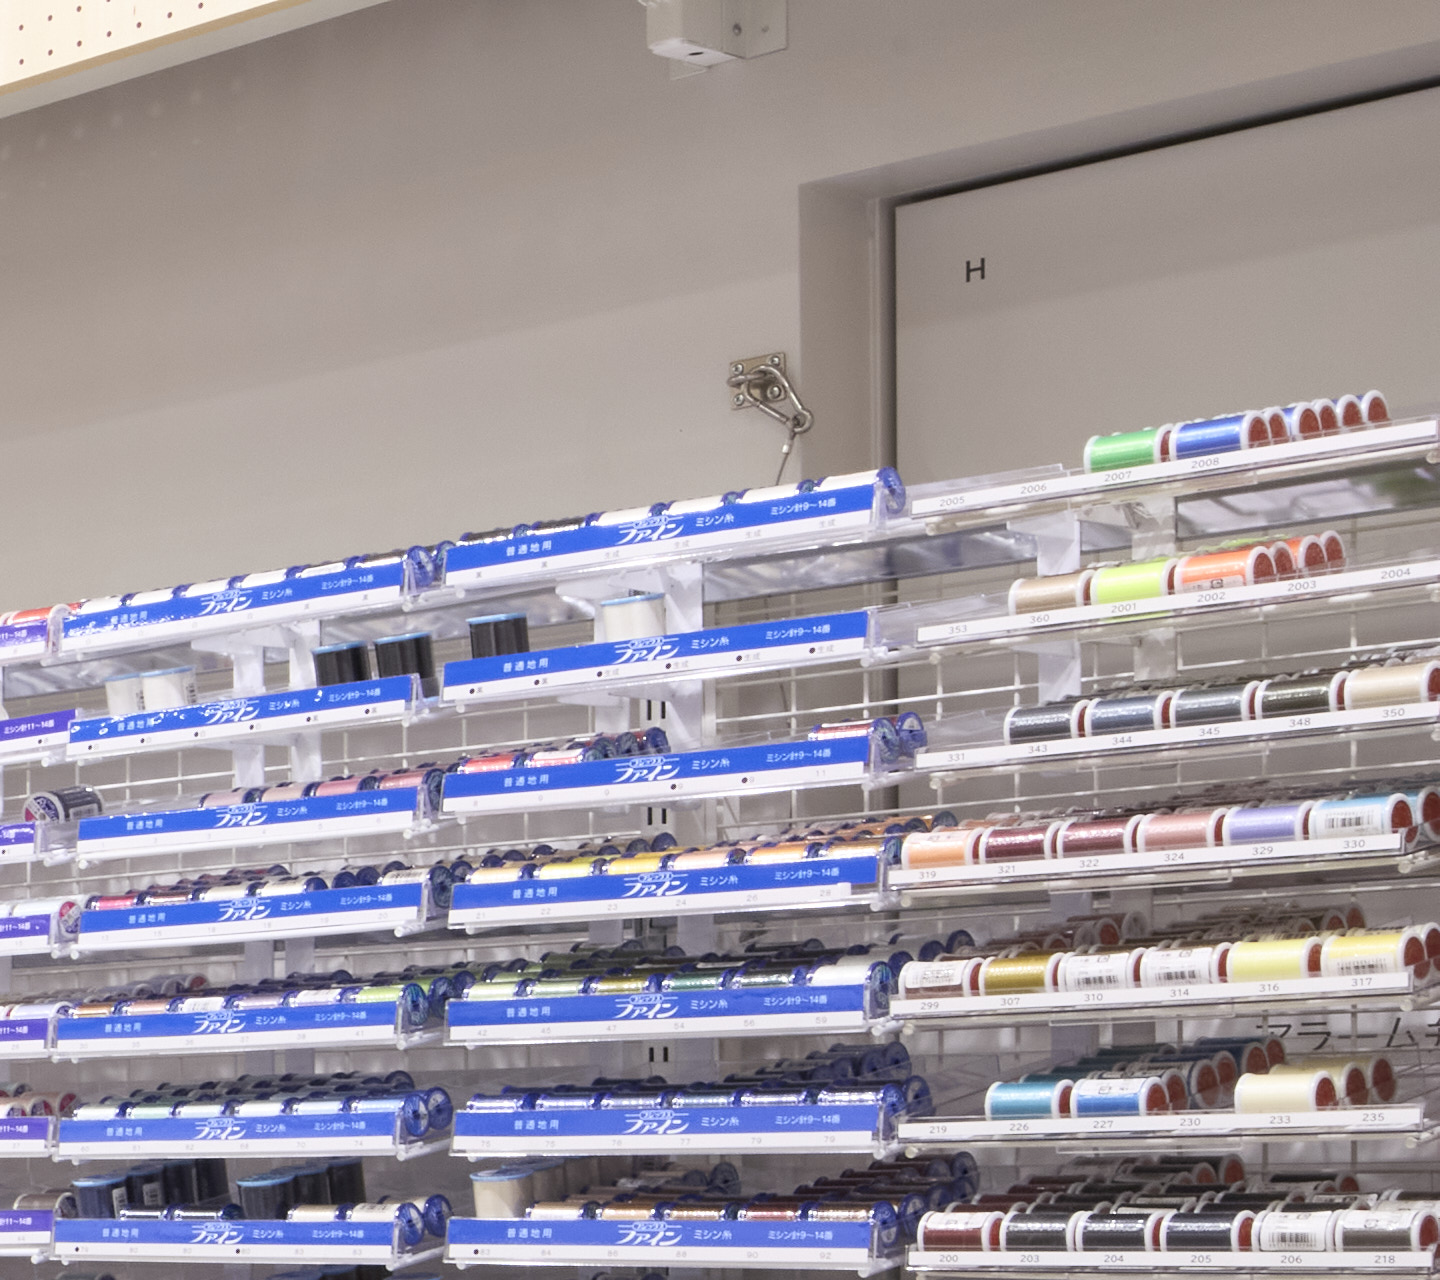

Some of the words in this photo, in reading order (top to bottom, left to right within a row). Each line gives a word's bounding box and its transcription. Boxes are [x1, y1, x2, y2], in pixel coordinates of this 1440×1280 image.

[964, 258, 987, 284] H
[940, 497, 964, 507] 2005
[1020, 482, 1048, 494] 2006
[1103, 470, 1132, 482] 2007
[1192, 458, 1219, 468] 2008
[950, 625, 967, 634] 353
[1112, 603, 1135, 613] 2001
[1288, 581, 1316, 591] 2003
[1381, 568, 1410, 579] 2004
[691, 636, 729, 649] ミシン糸
[1029, 745, 1047, 753] 343
[1383, 708, 1405, 718] 350
[997, 864, 1016, 873] 321
[1344, 840, 1365, 848] 330
[699, 874, 739, 889] ミシン糸
[1084, 992, 1103, 1002] 310
[1010, 1123, 1029, 1131] 226
[1363, 1113, 1384, 1121] 235
[939, 1253, 959, 1263] 200
[1374, 1254, 1395, 1264] 218
